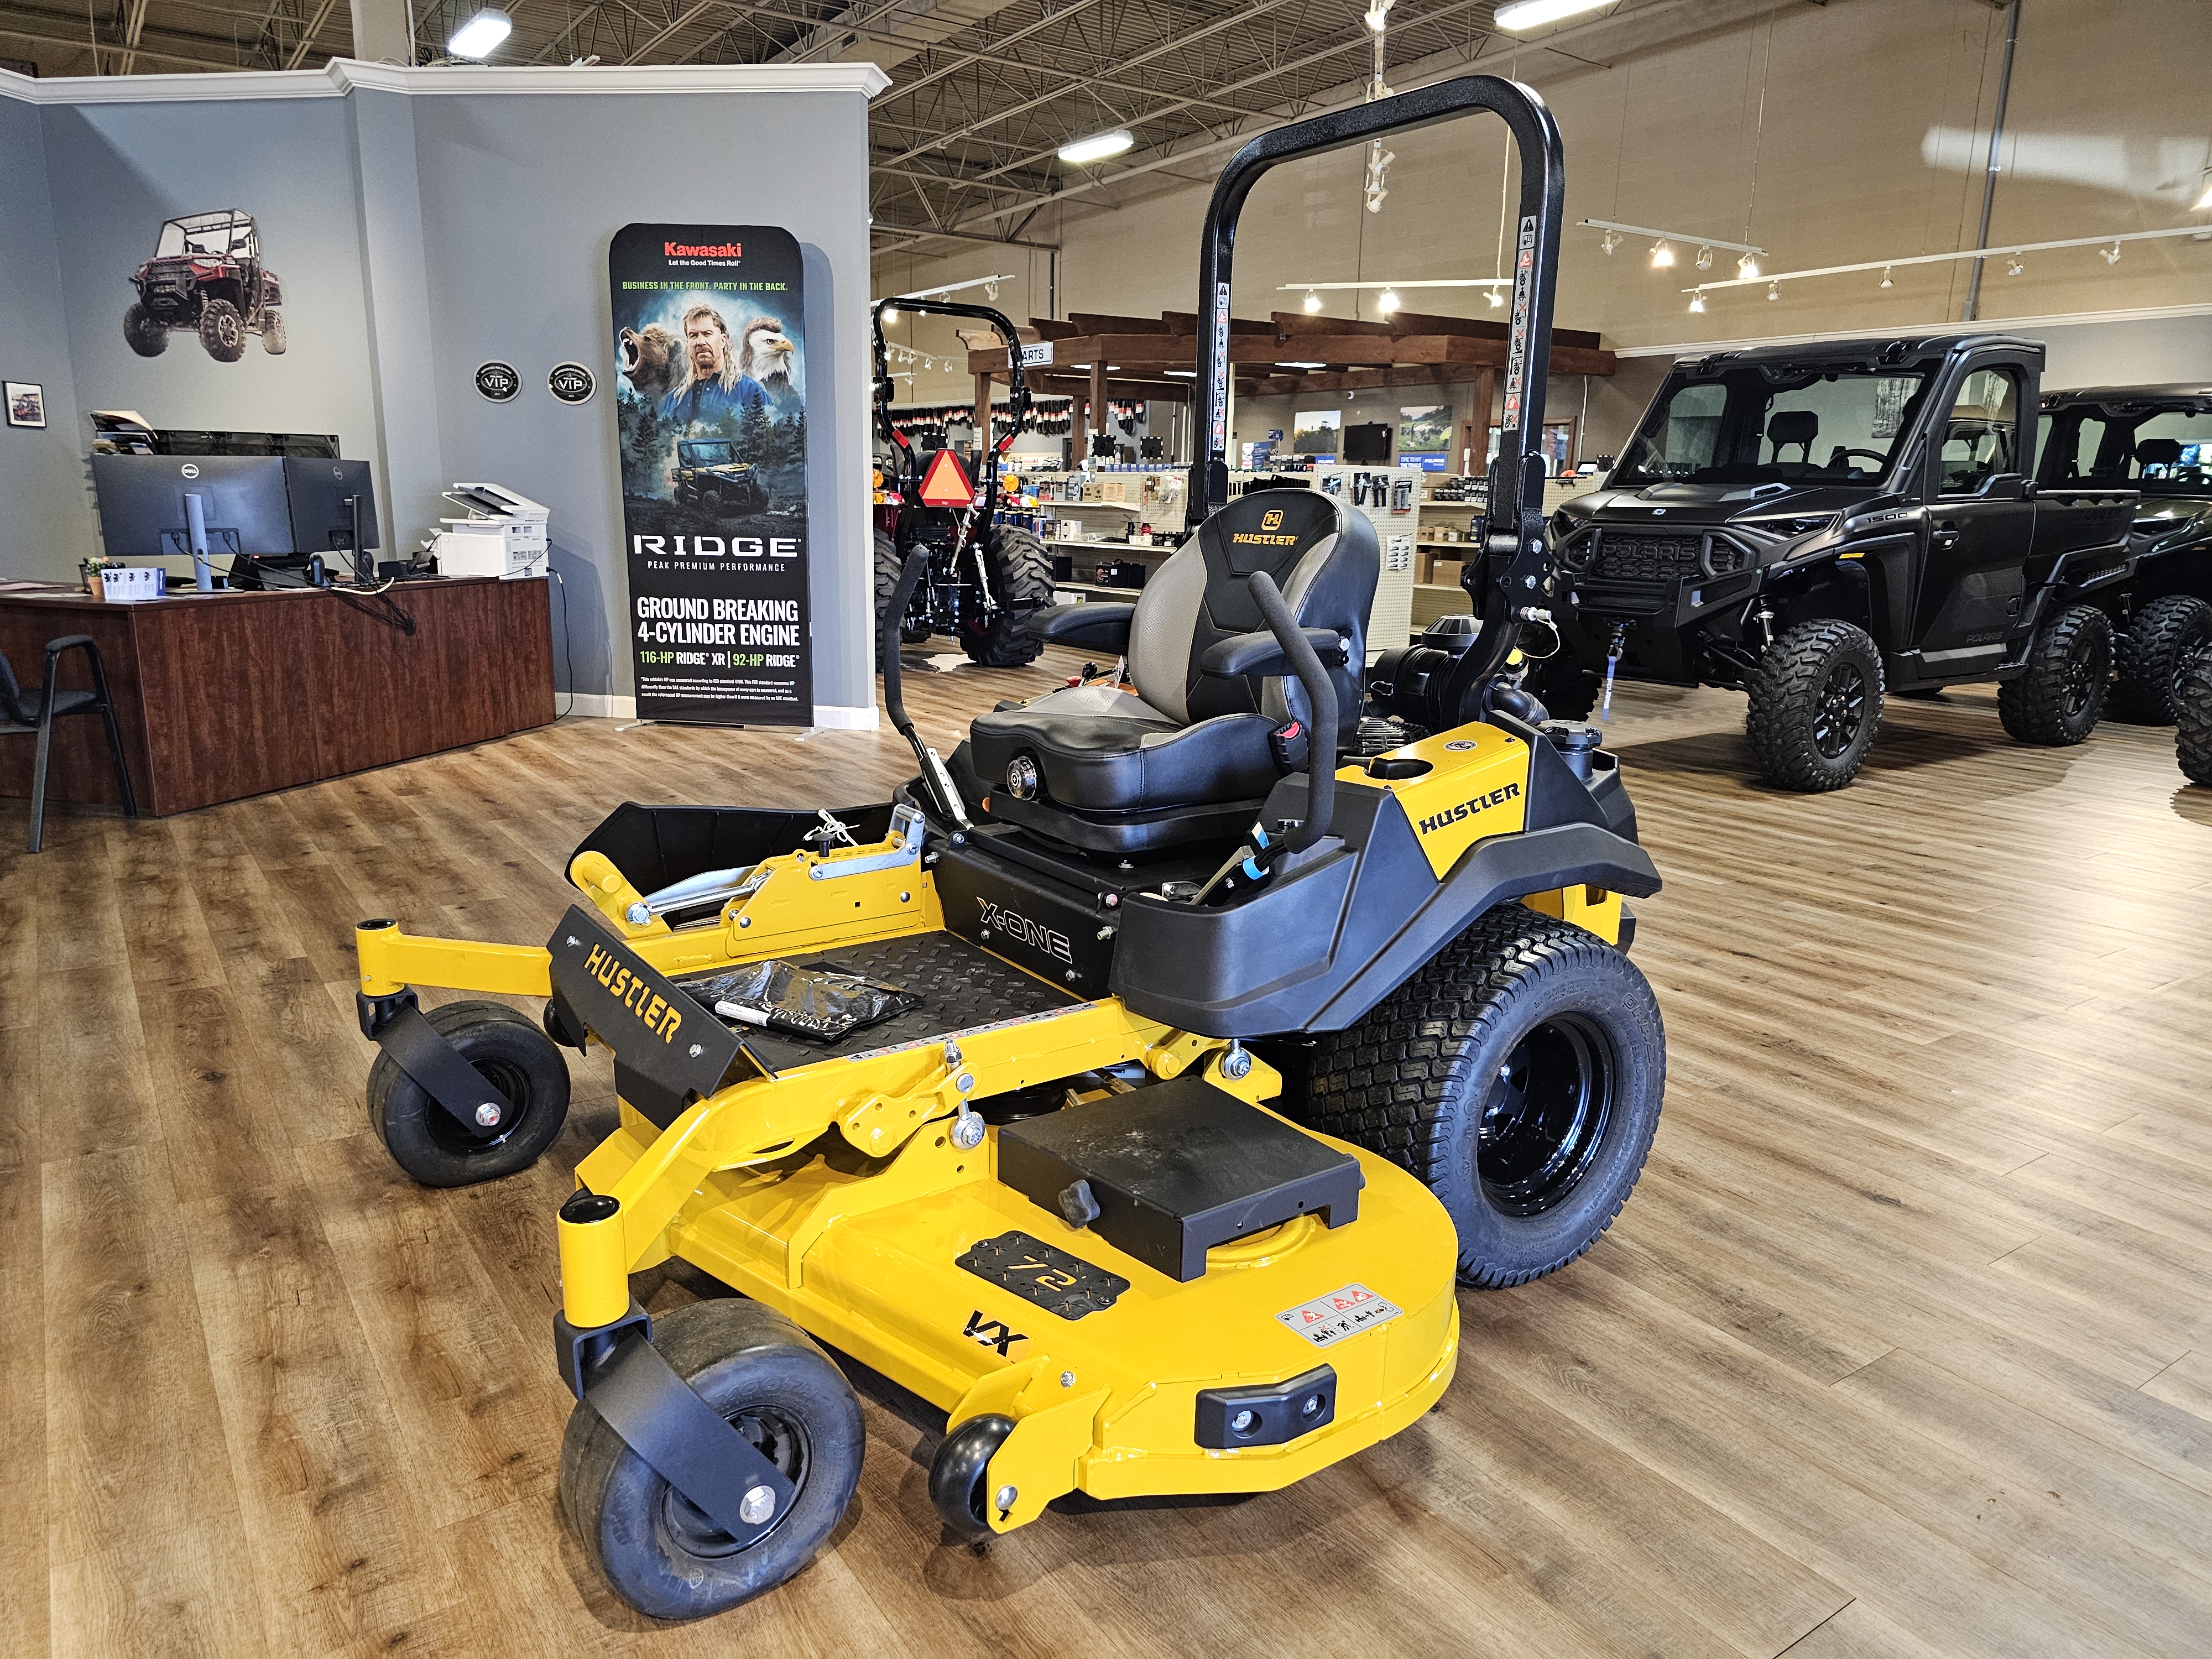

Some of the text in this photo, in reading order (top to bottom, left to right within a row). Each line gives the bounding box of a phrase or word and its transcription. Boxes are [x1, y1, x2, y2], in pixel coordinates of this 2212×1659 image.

[665, 242, 742, 257] Kawasaki
[623, 281, 788, 291] BUSINESS IN THE FRONT. PARTY IN THE BACK.
[1022, 348, 1044, 361] ARTS
[484, 377, 509, 388] VIP
[558, 379, 583, 390] VIP
[1867, 512, 1908, 523] 1500
[634, 535, 797, 557] RIDGE
[1233, 533, 1296, 546] HUSTLER
[1604, 545, 1695, 560] POLARIS
[648, 561, 785, 572] PEAK PREMIUM PERFORMANCE
[637, 597, 798, 622] GROUND BREAKING
[638, 621, 800, 646] 4-CYLINDER ENGINE
[1966, 631, 2003, 643] POLARIS
[640, 651, 674, 664] 116-HP
[712, 653, 726, 665] XR
[733, 654, 764, 666] 92-HP
[1604, 678, 1613, 709] POLARIS
[1418, 782, 1520, 834] HUSTLER
[976, 896, 1073, 964] X-ONE
[583, 943, 682, 1044] HUSTLER
[1008, 1254, 1077, 1292] 72
[962, 1310, 1030, 1358] VX
